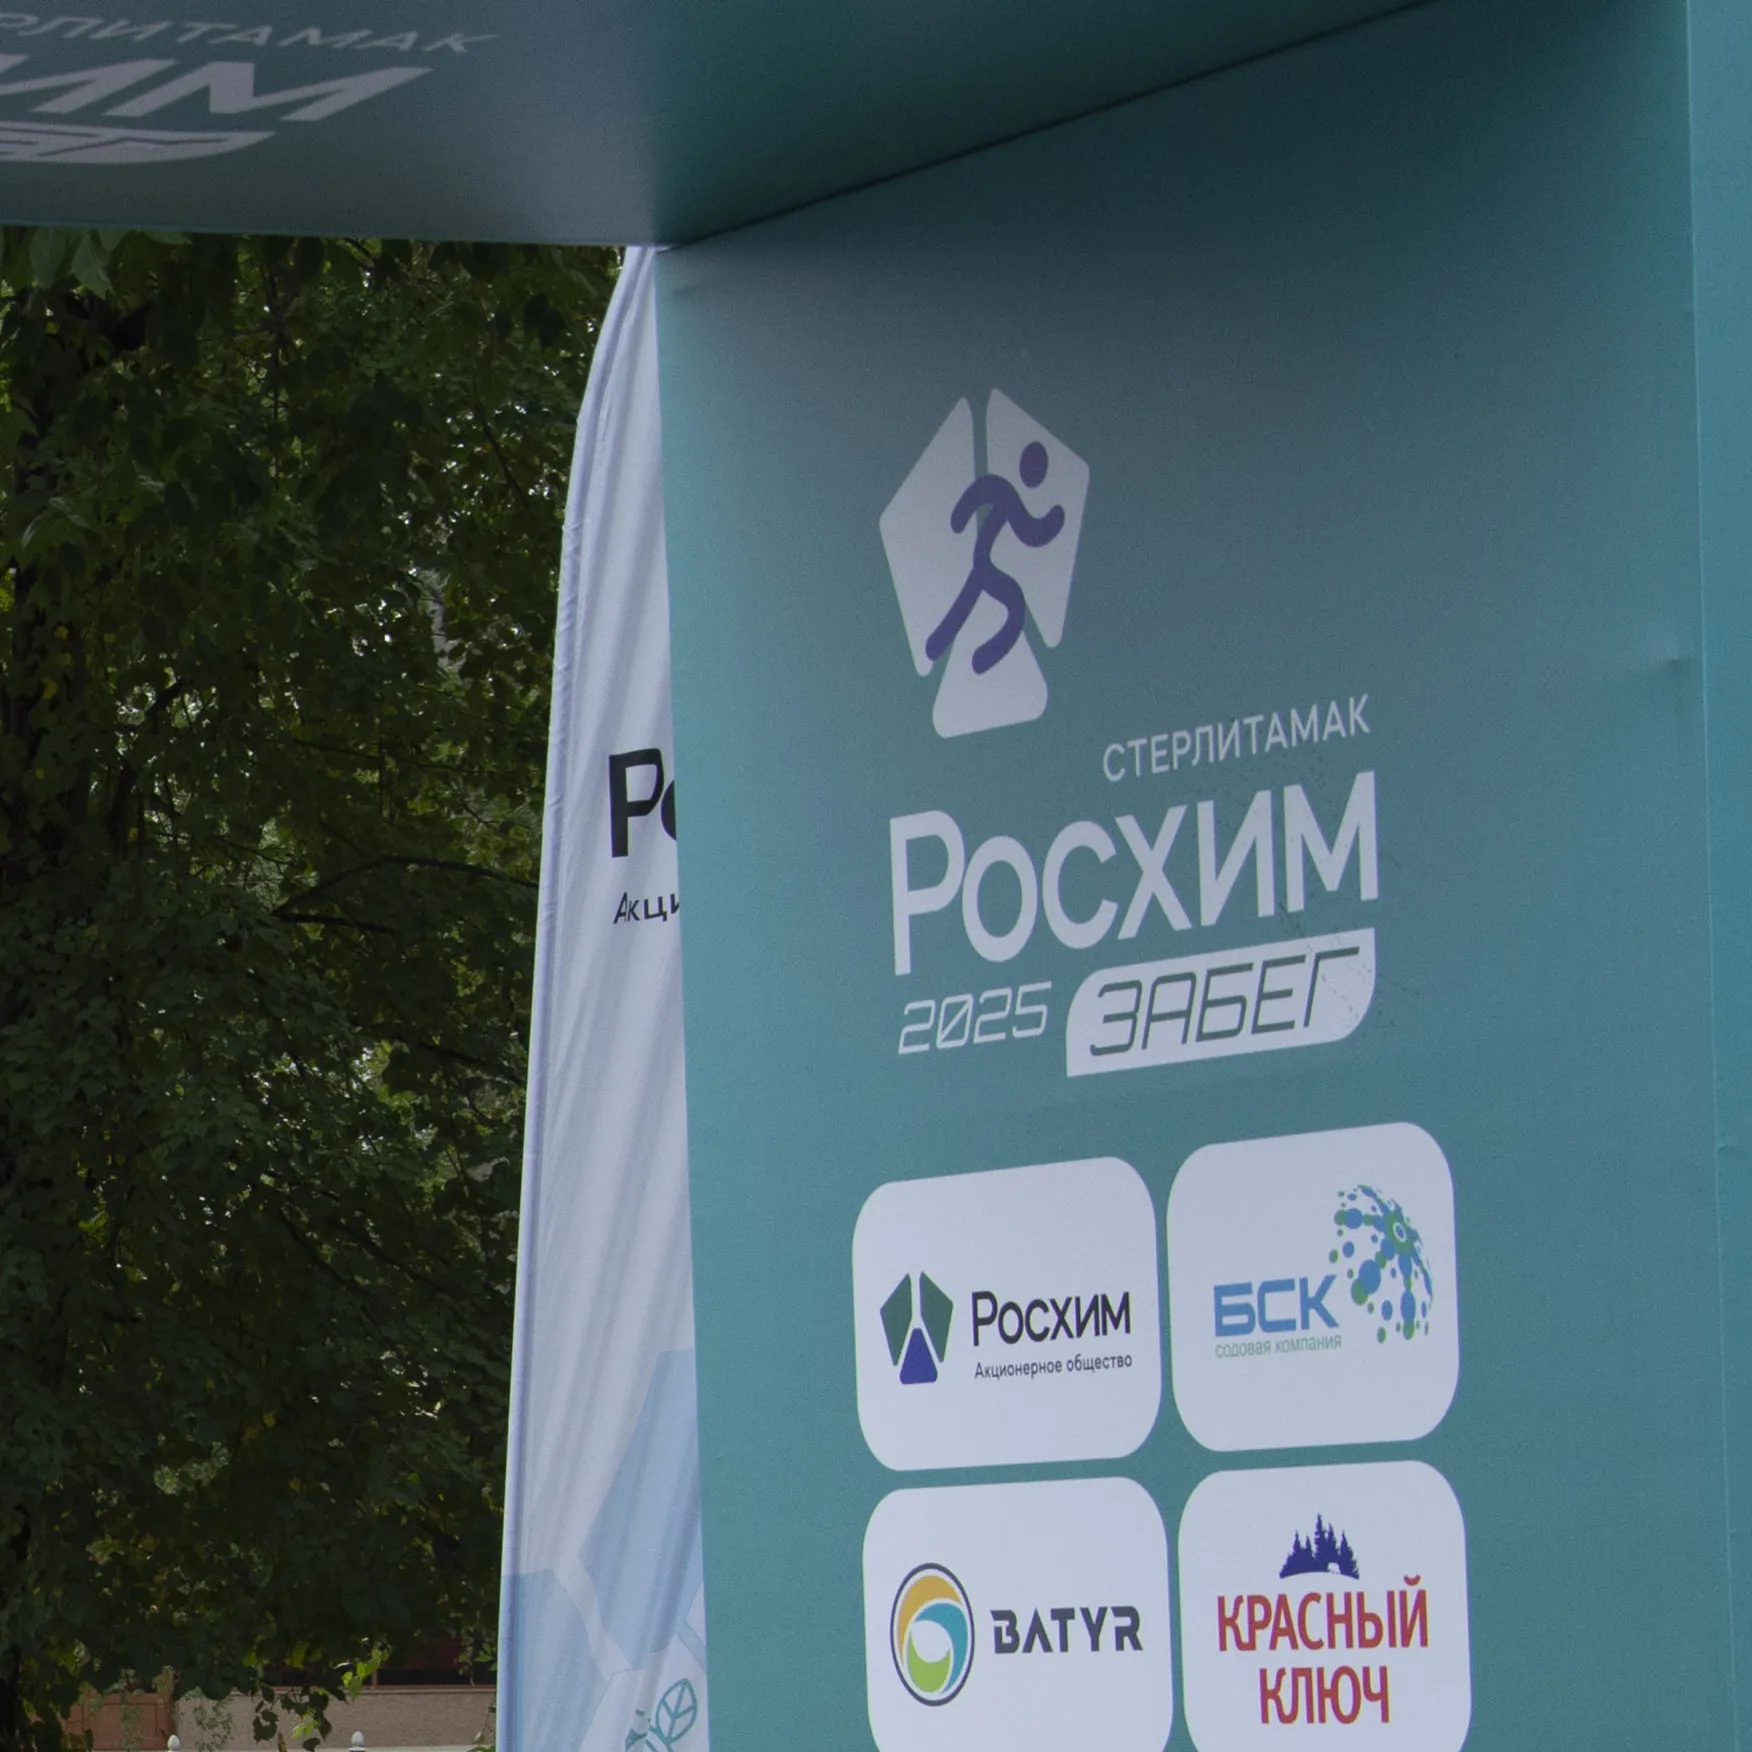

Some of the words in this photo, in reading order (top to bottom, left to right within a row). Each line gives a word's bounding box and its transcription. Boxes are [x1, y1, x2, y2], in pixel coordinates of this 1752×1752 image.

[1103, 694, 1370, 782] СТЕРЛИТАМАК
[898, 981, 1052, 1054] 2025
[1089, 946, 1360, 1057] ЗАБЕГ
[1214, 1274, 1339, 1337] БСК
[975, 1360, 1062, 1380] Акционерное
[1066, 1353, 1132, 1373] общество
[1215, 1340, 1271, 1358] содовая
[1275, 1335, 1341, 1353] компания
[990, 1605, 1143, 1654] BATYR
[1217, 1574, 1429, 1652] КРАСНЫЙ
[1259, 1666, 1390, 1725] КЛЮЧ
